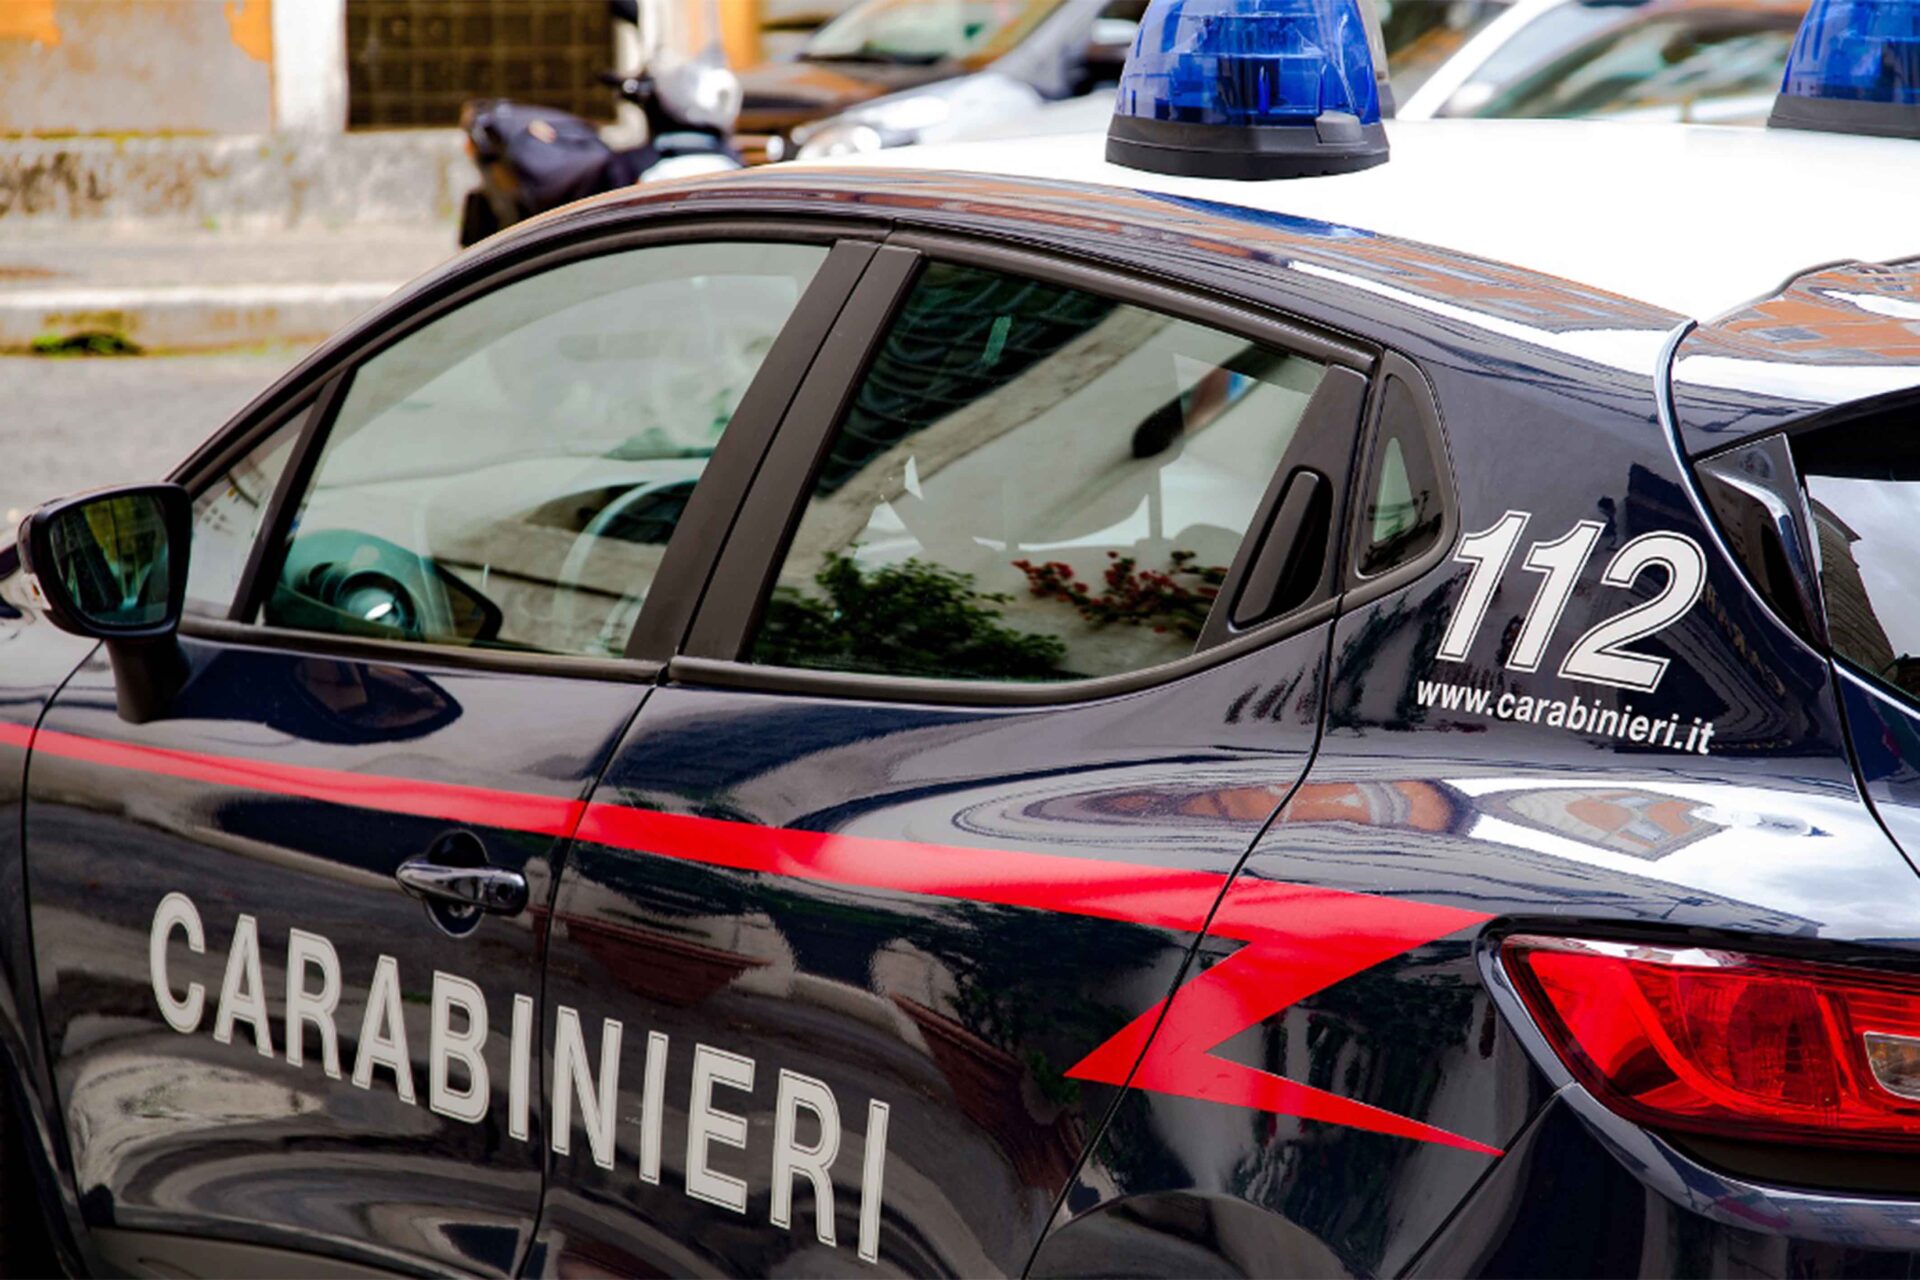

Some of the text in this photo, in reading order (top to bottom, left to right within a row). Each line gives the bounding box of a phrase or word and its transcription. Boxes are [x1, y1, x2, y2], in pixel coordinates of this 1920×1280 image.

[1435, 509, 1708, 694] 112
[1416, 680, 1716, 756] www.carabinieri.it
[149, 892, 891, 1265] CARABINIERI
